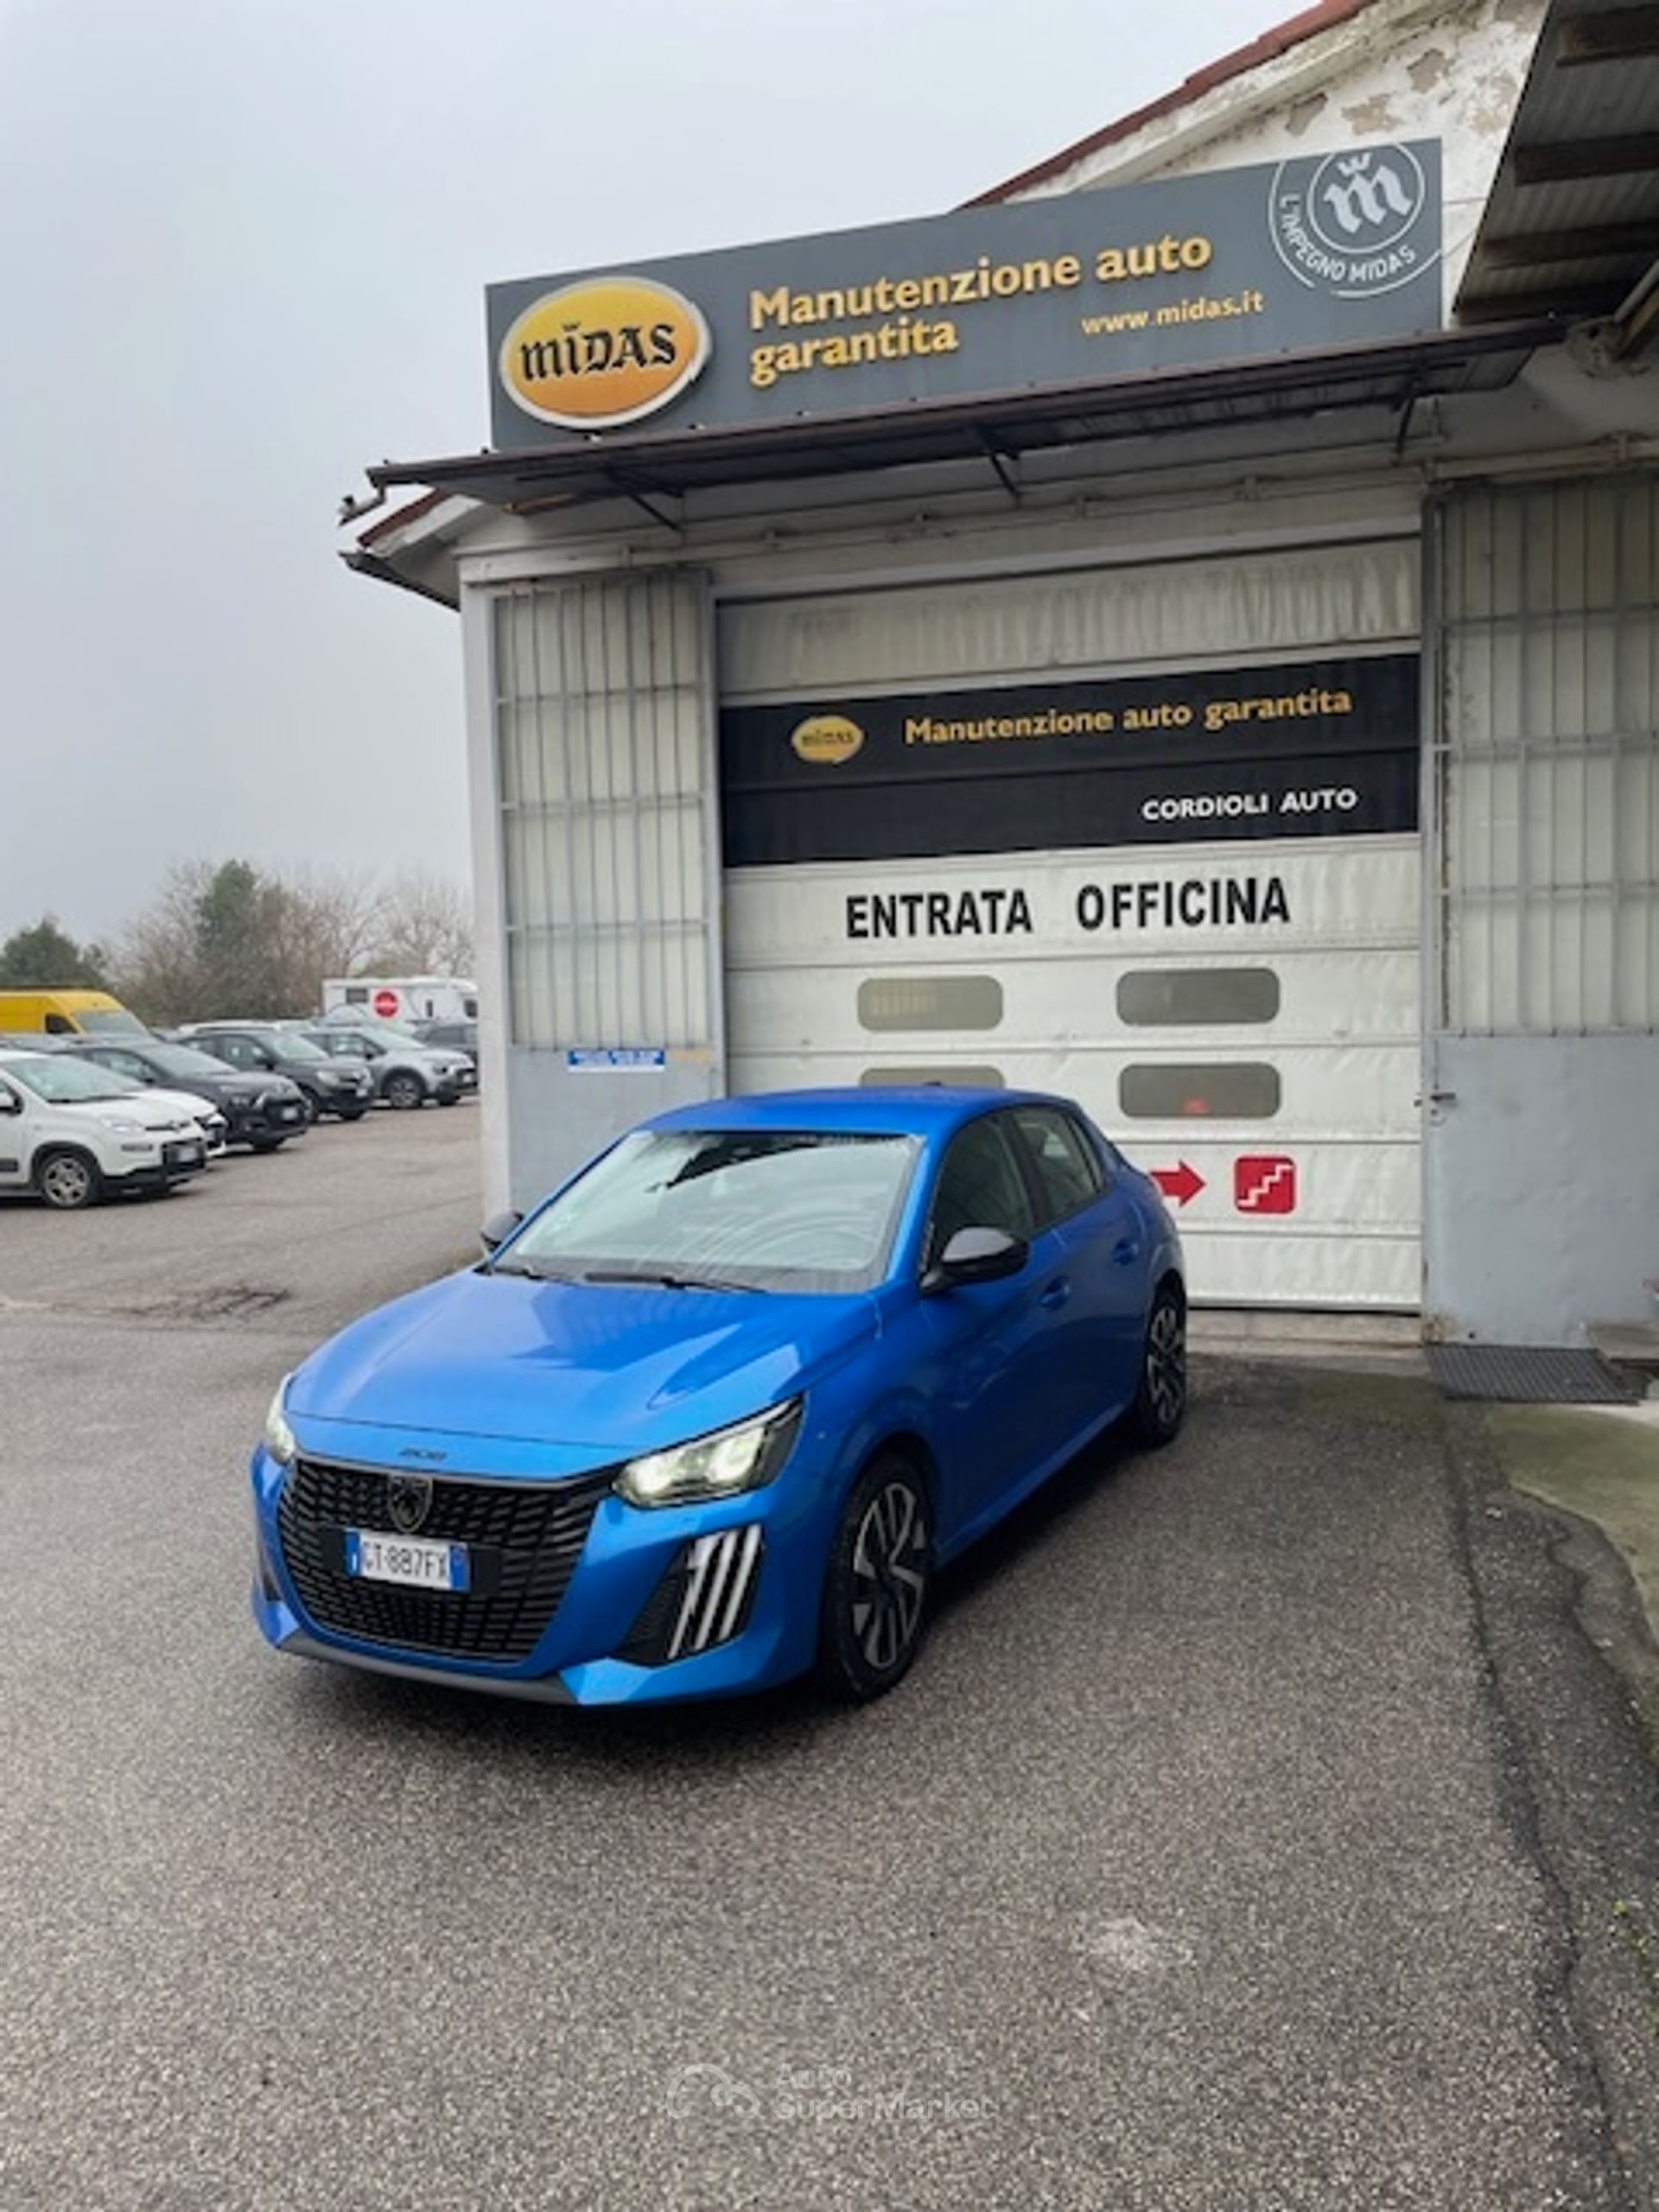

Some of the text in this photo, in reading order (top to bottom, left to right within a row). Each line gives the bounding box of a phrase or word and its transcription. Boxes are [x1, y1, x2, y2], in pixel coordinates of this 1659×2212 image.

[749, 234, 1212, 330] Manutenzione auto
[1347, 244, 1416, 283] MIDAS
[1081, 290, 1264, 334] www.midas.it
[749, 315, 960, 387] garantita
[903, 688, 1353, 747] Manutenzione auto garantita
[1142, 787, 1358, 821] CORDIOLI AUTO
[845, 876, 1292, 938] ENTRATA OFFICINA
